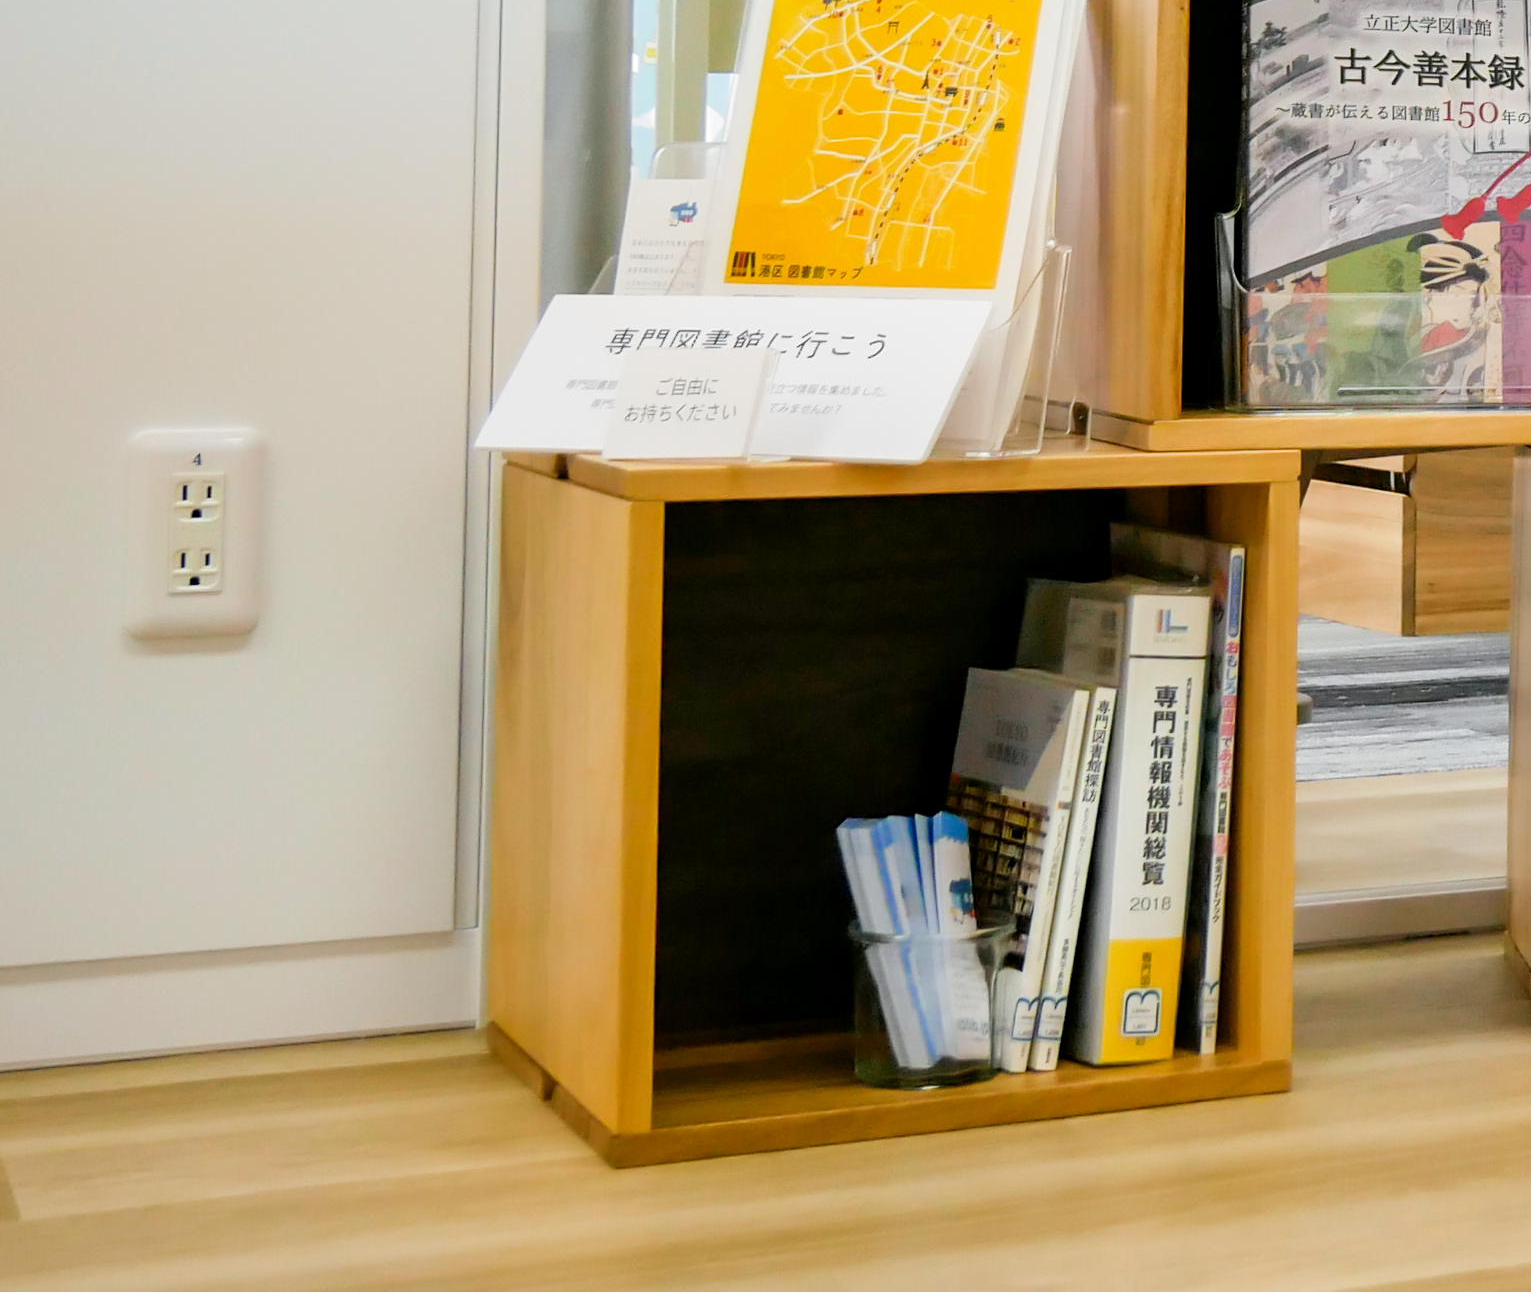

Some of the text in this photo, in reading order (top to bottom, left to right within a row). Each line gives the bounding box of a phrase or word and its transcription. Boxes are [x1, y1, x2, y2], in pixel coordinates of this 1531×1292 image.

[1363, 15, 1493, 37] 立正大学図書館
[1334, 47, 1525, 90] 古今善本録
[758, 265, 864, 279] 港区 図書館マップ
[605, 327, 888, 359] 専門図書館に行こう
[656, 377, 720, 397] ご自由に
[624, 402, 738, 424] お持ちください
[1082, 699, 1111, 803] 専門図書館探訪
[1141, 684, 1179, 886] 専門情報機関総覧
[1129, 896, 1172, 912] 2018
